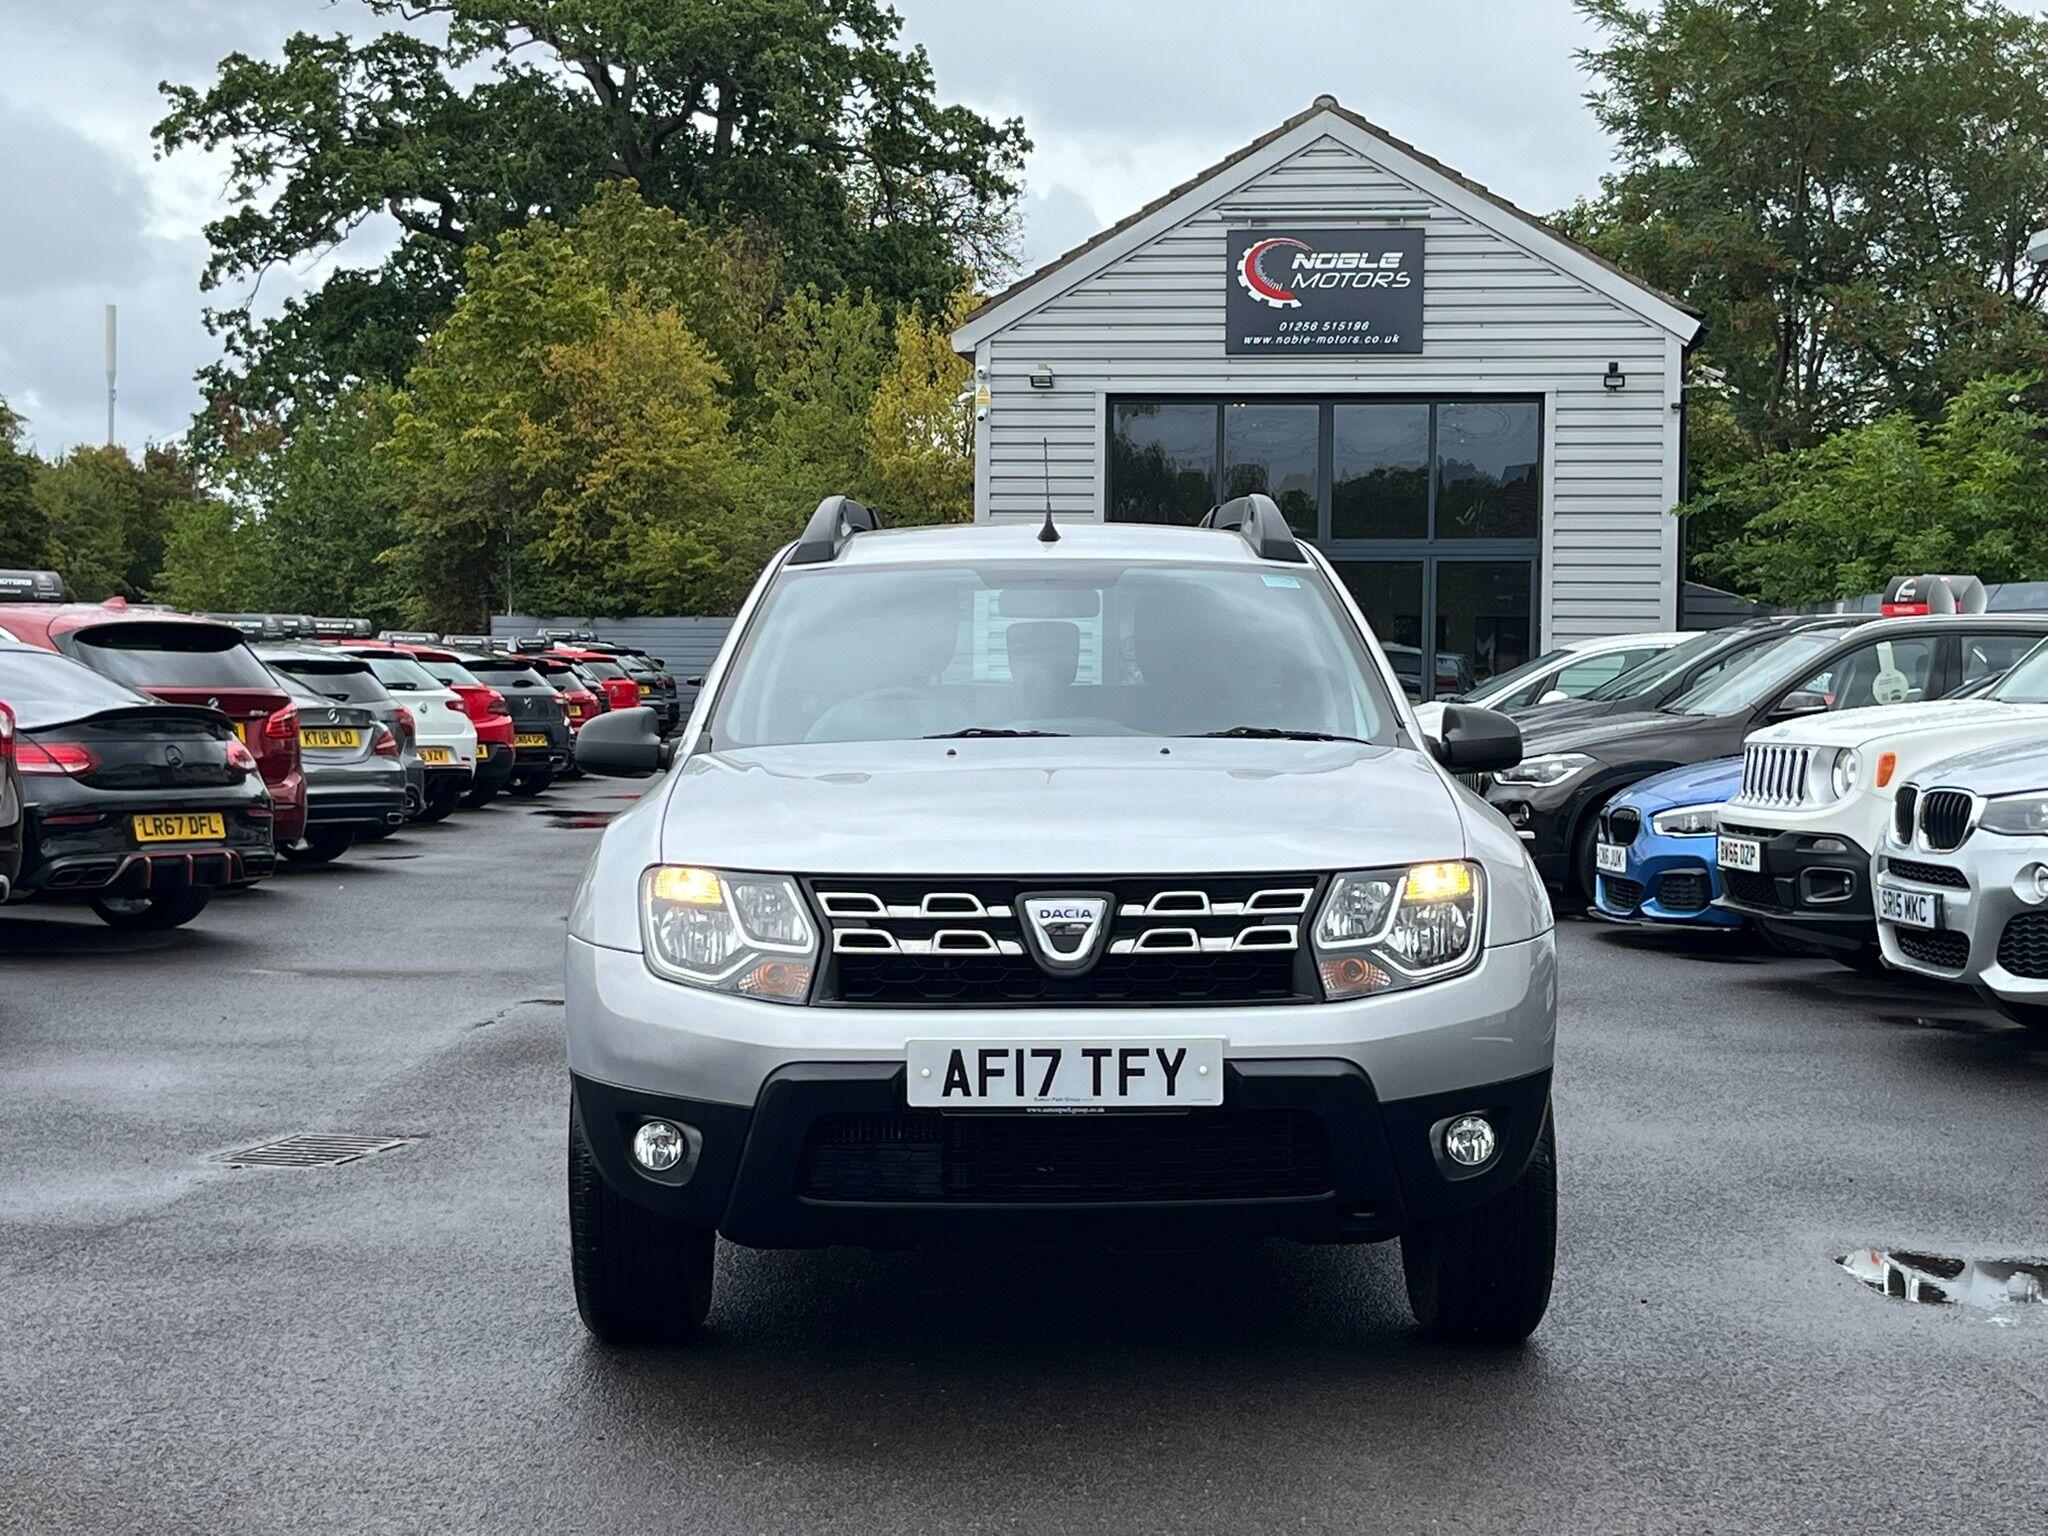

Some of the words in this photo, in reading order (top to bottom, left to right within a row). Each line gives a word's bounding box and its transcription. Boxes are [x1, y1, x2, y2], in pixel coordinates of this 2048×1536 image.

[1291, 252, 1404, 270] NOBLE
[1291, 271, 1412, 289] MOTORS
[1243, 333, 1400, 345] www.noble-motors.co.uk
[141, 816, 183, 836] LR67
[188, 815, 219, 835] DFL
[1039, 908, 1093, 919] DACIA
[941, 1047, 1062, 1098] AF17
[1081, 1047, 1187, 1097] TFY
